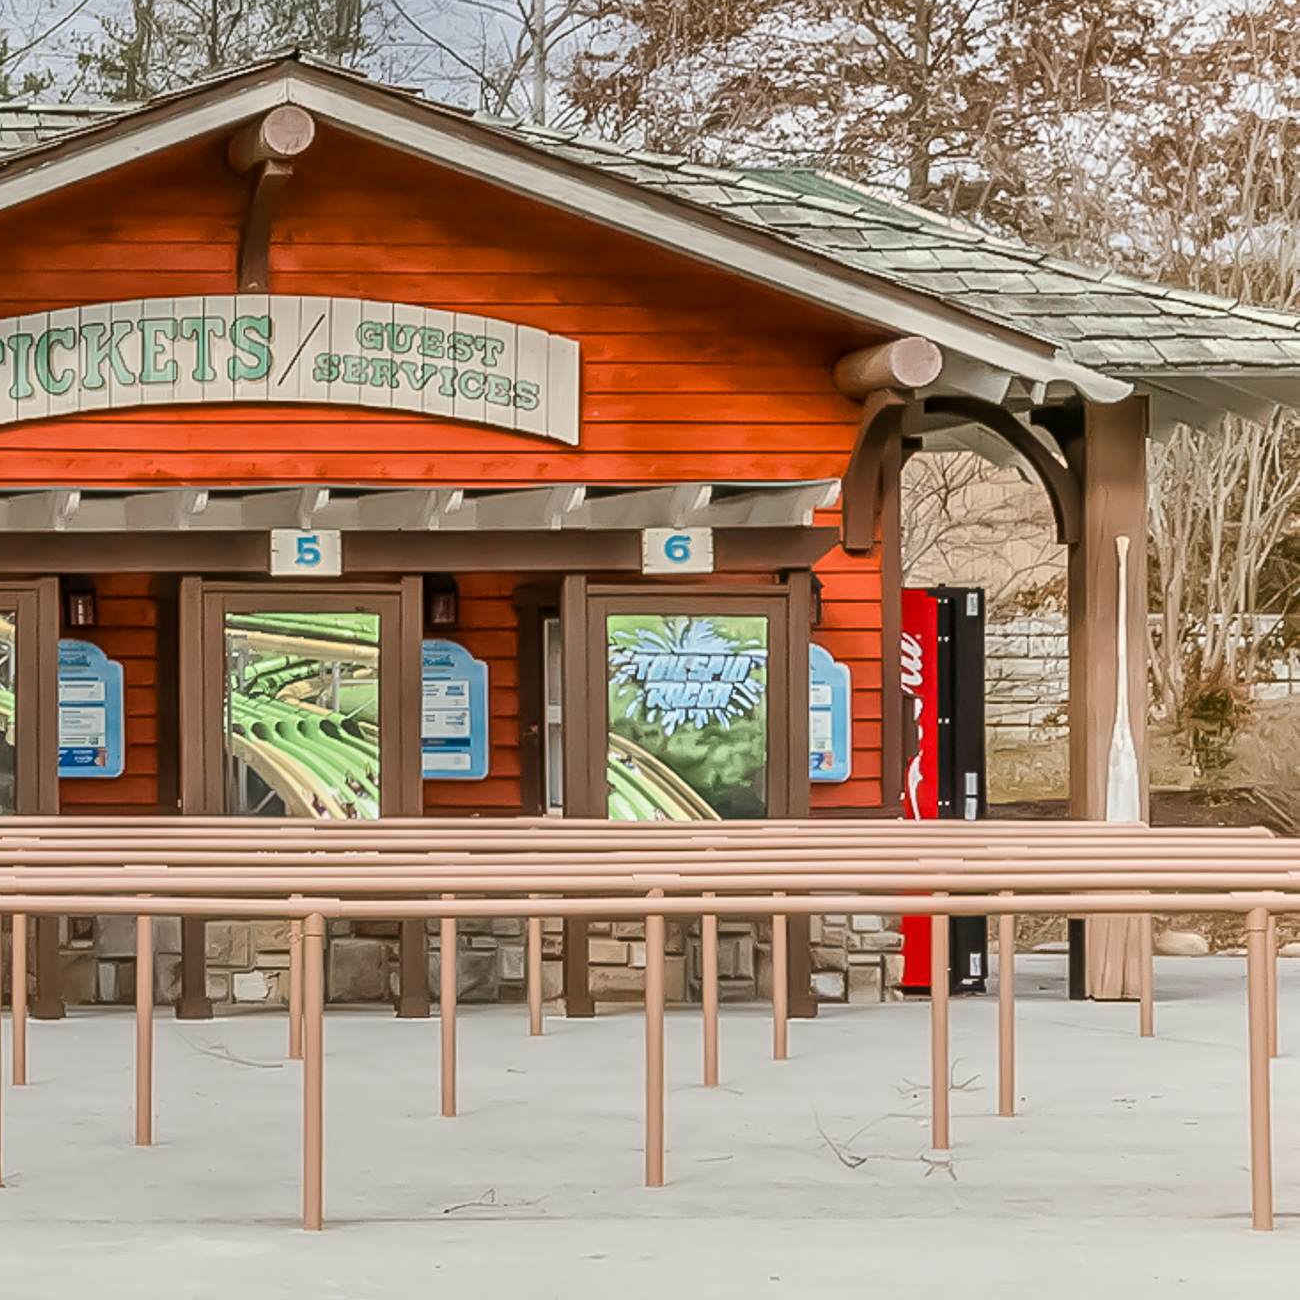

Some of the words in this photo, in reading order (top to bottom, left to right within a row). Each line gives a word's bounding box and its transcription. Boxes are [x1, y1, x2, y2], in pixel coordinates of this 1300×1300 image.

[356, 320, 504, 368] GUEST
[312, 352, 540, 411] SERVICES
[294, 536, 321, 566] 5
[663, 535, 692, 563] 6
